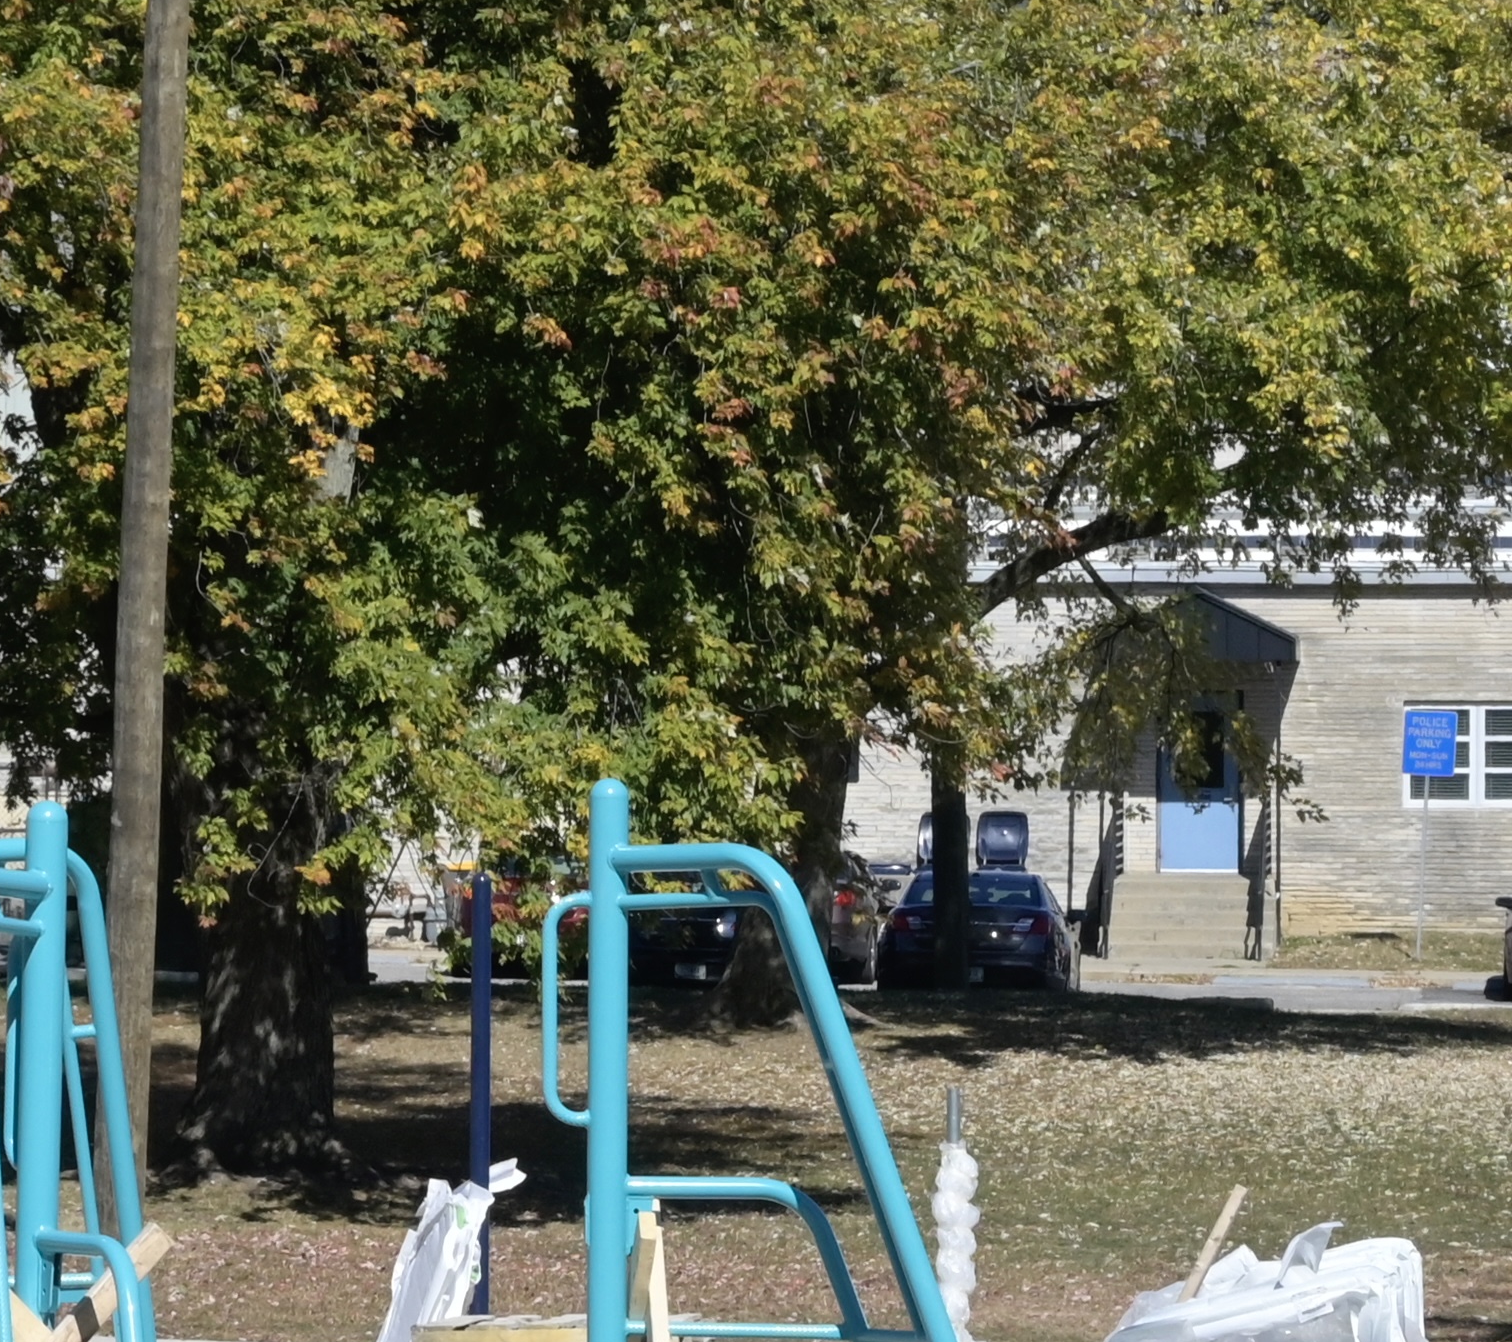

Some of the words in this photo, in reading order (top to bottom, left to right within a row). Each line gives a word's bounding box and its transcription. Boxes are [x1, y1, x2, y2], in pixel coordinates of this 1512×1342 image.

[1412, 716, 1449, 728] POLICE
[1408, 727, 1452, 739] PARKING
[1415, 738, 1443, 749] ONLY
